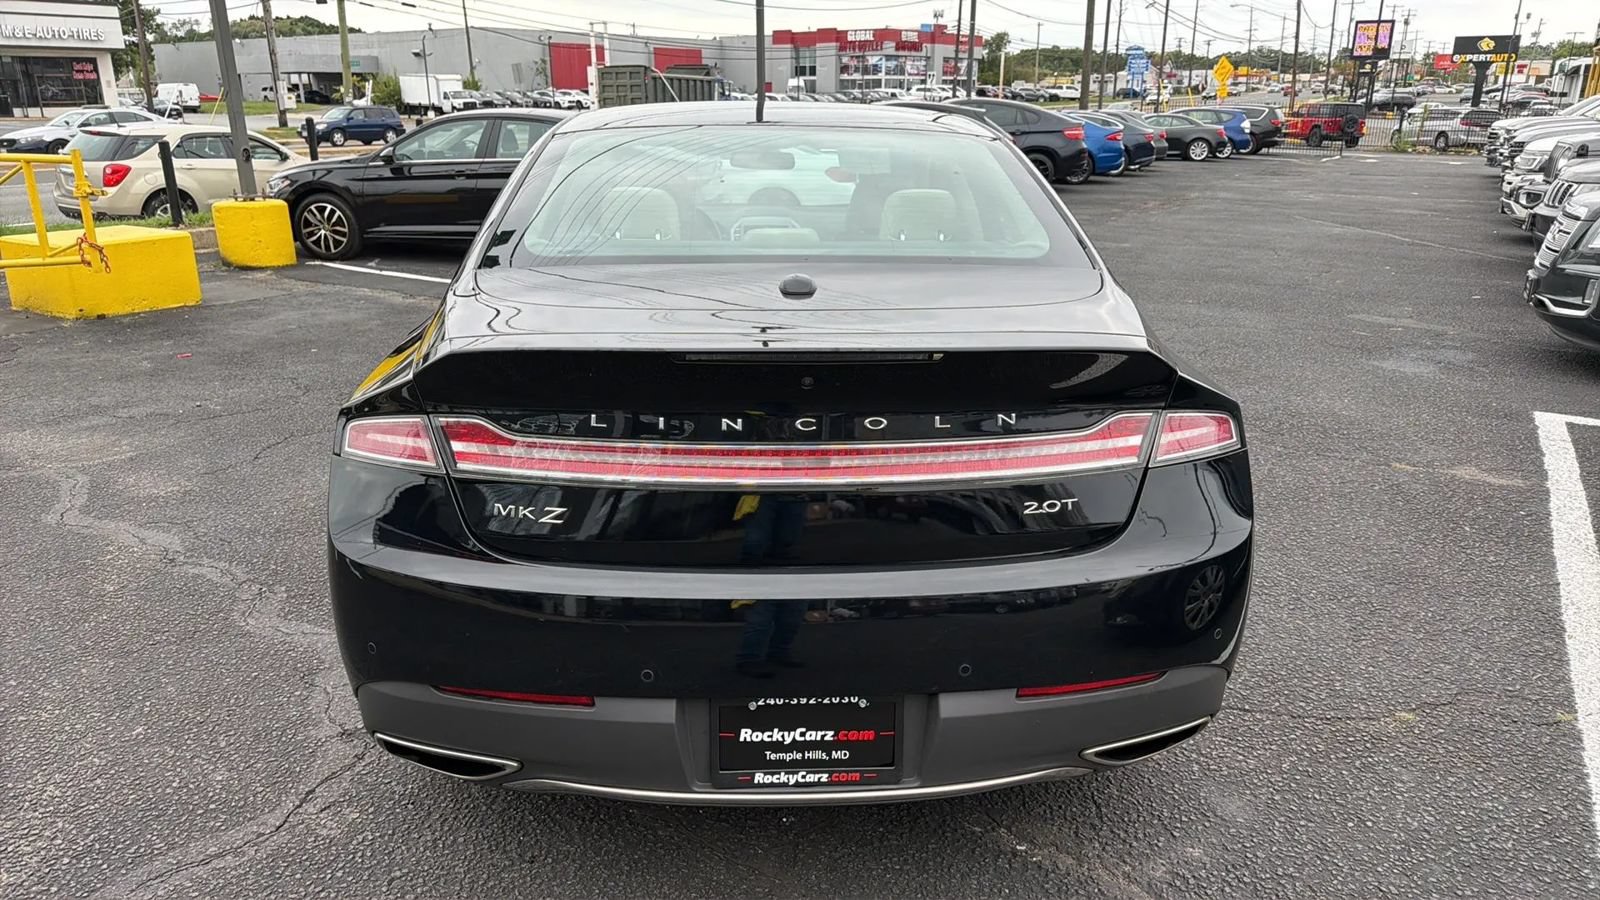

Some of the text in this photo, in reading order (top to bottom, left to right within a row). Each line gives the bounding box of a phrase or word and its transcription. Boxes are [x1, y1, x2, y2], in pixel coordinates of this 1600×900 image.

[36, 25, 68, 39] AUTO
[71, 28, 105, 40] TIRES
[847, 30, 875, 41] GLOBAL
[590, 412, 1016, 431] LINCOLN
[493, 503, 568, 524] MKZ
[739, 727, 875, 744] RockyCarz.com
[765, 750, 850, 762] Temple Hills, MD
[754, 771, 861, 785] RockyCarz.com
